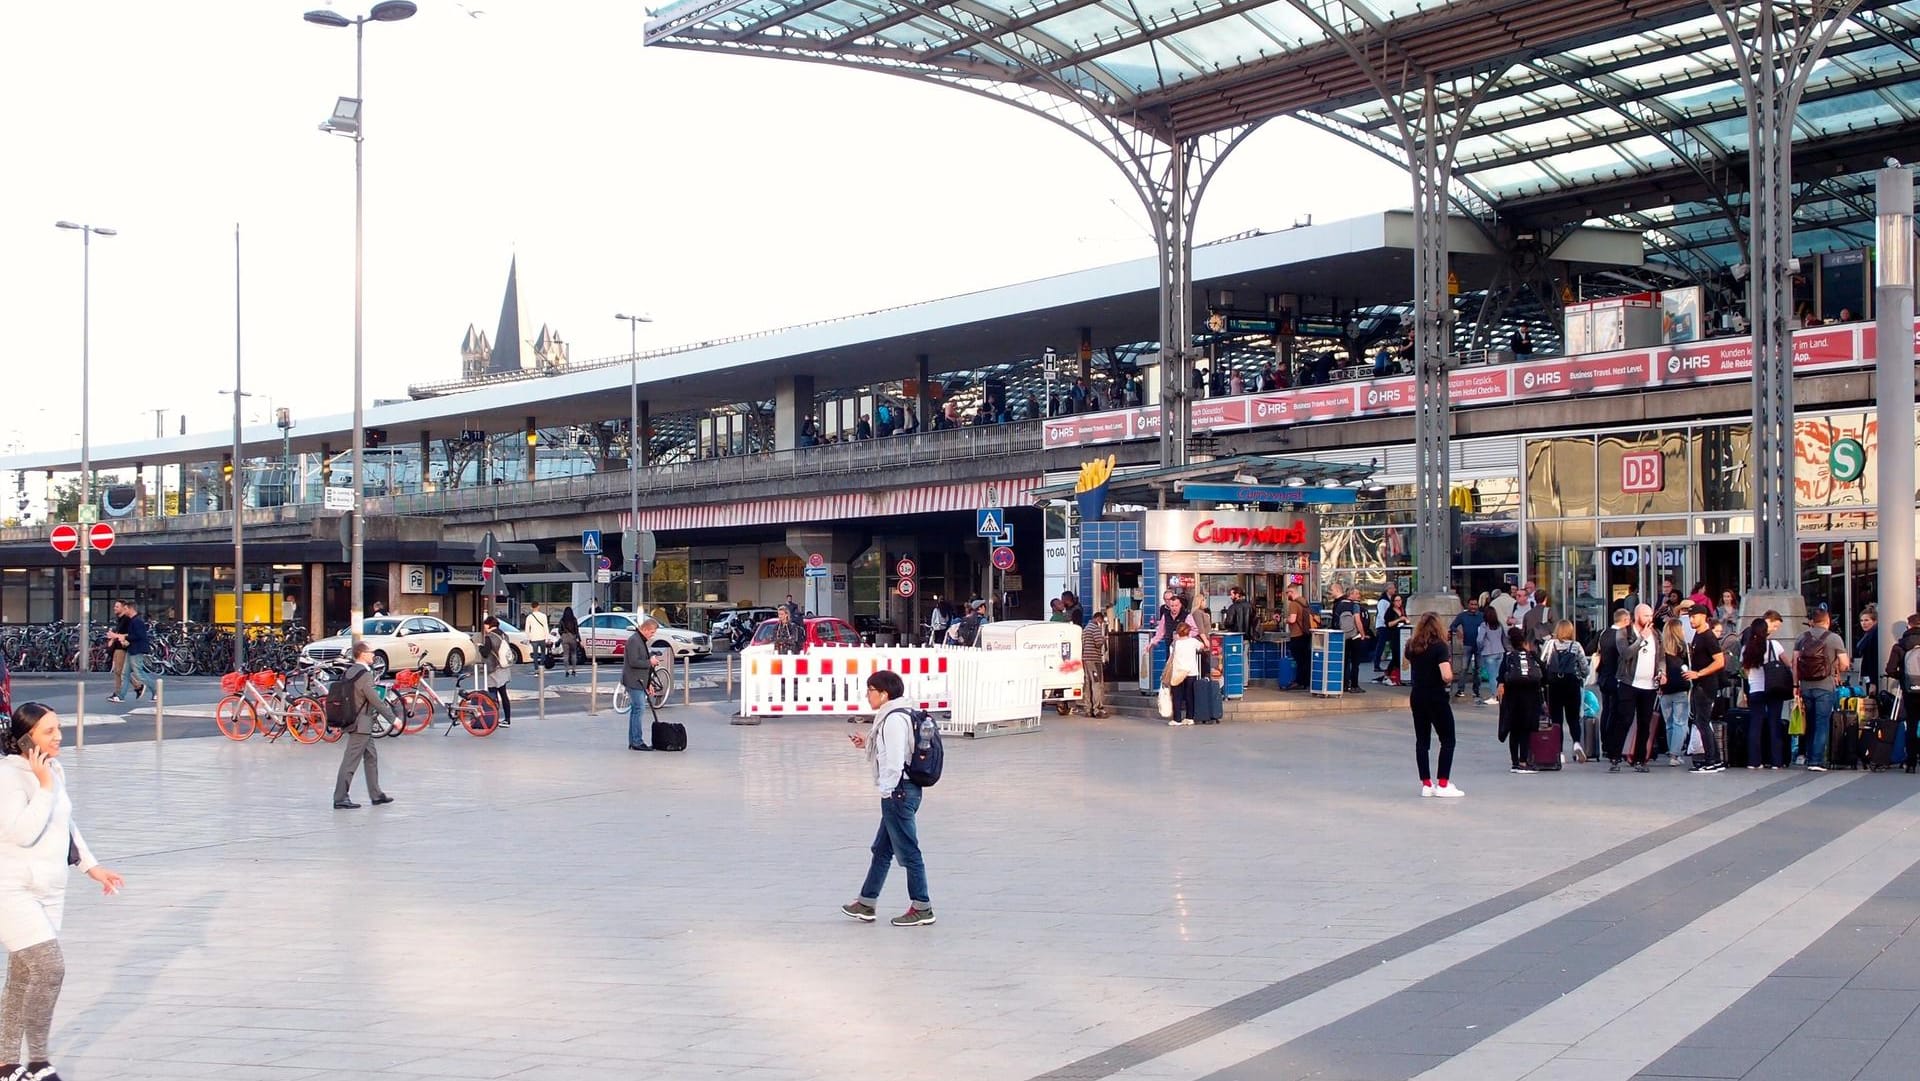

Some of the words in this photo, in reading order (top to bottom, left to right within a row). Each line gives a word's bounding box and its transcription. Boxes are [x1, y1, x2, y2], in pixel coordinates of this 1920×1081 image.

[1720, 348, 1746, 358] Kunden
[1046, 354, 1055, 370] H
[1683, 355, 1710, 370] HRS
[1721, 359, 1734, 370] Alle
[1537, 371, 1560, 385] HRS
[1570, 371, 1593, 380] Business
[1594, 368, 1612, 377] Travel.
[1613, 367, 1626, 376] Next
[1627, 364, 1643, 374] Level.
[1379, 390, 1400, 401] HRS
[1268, 403, 1287, 413] HRS
[1058, 427, 1073, 437] HRS
[1834, 443, 1856, 478] S
[1626, 458, 1656, 486] DB
[1238, 486, 1303, 500] Currywurst
[1193, 519, 1304, 545] Currywurst
[1046, 548, 1054, 558] TO
[434, 567, 445, 591] P
